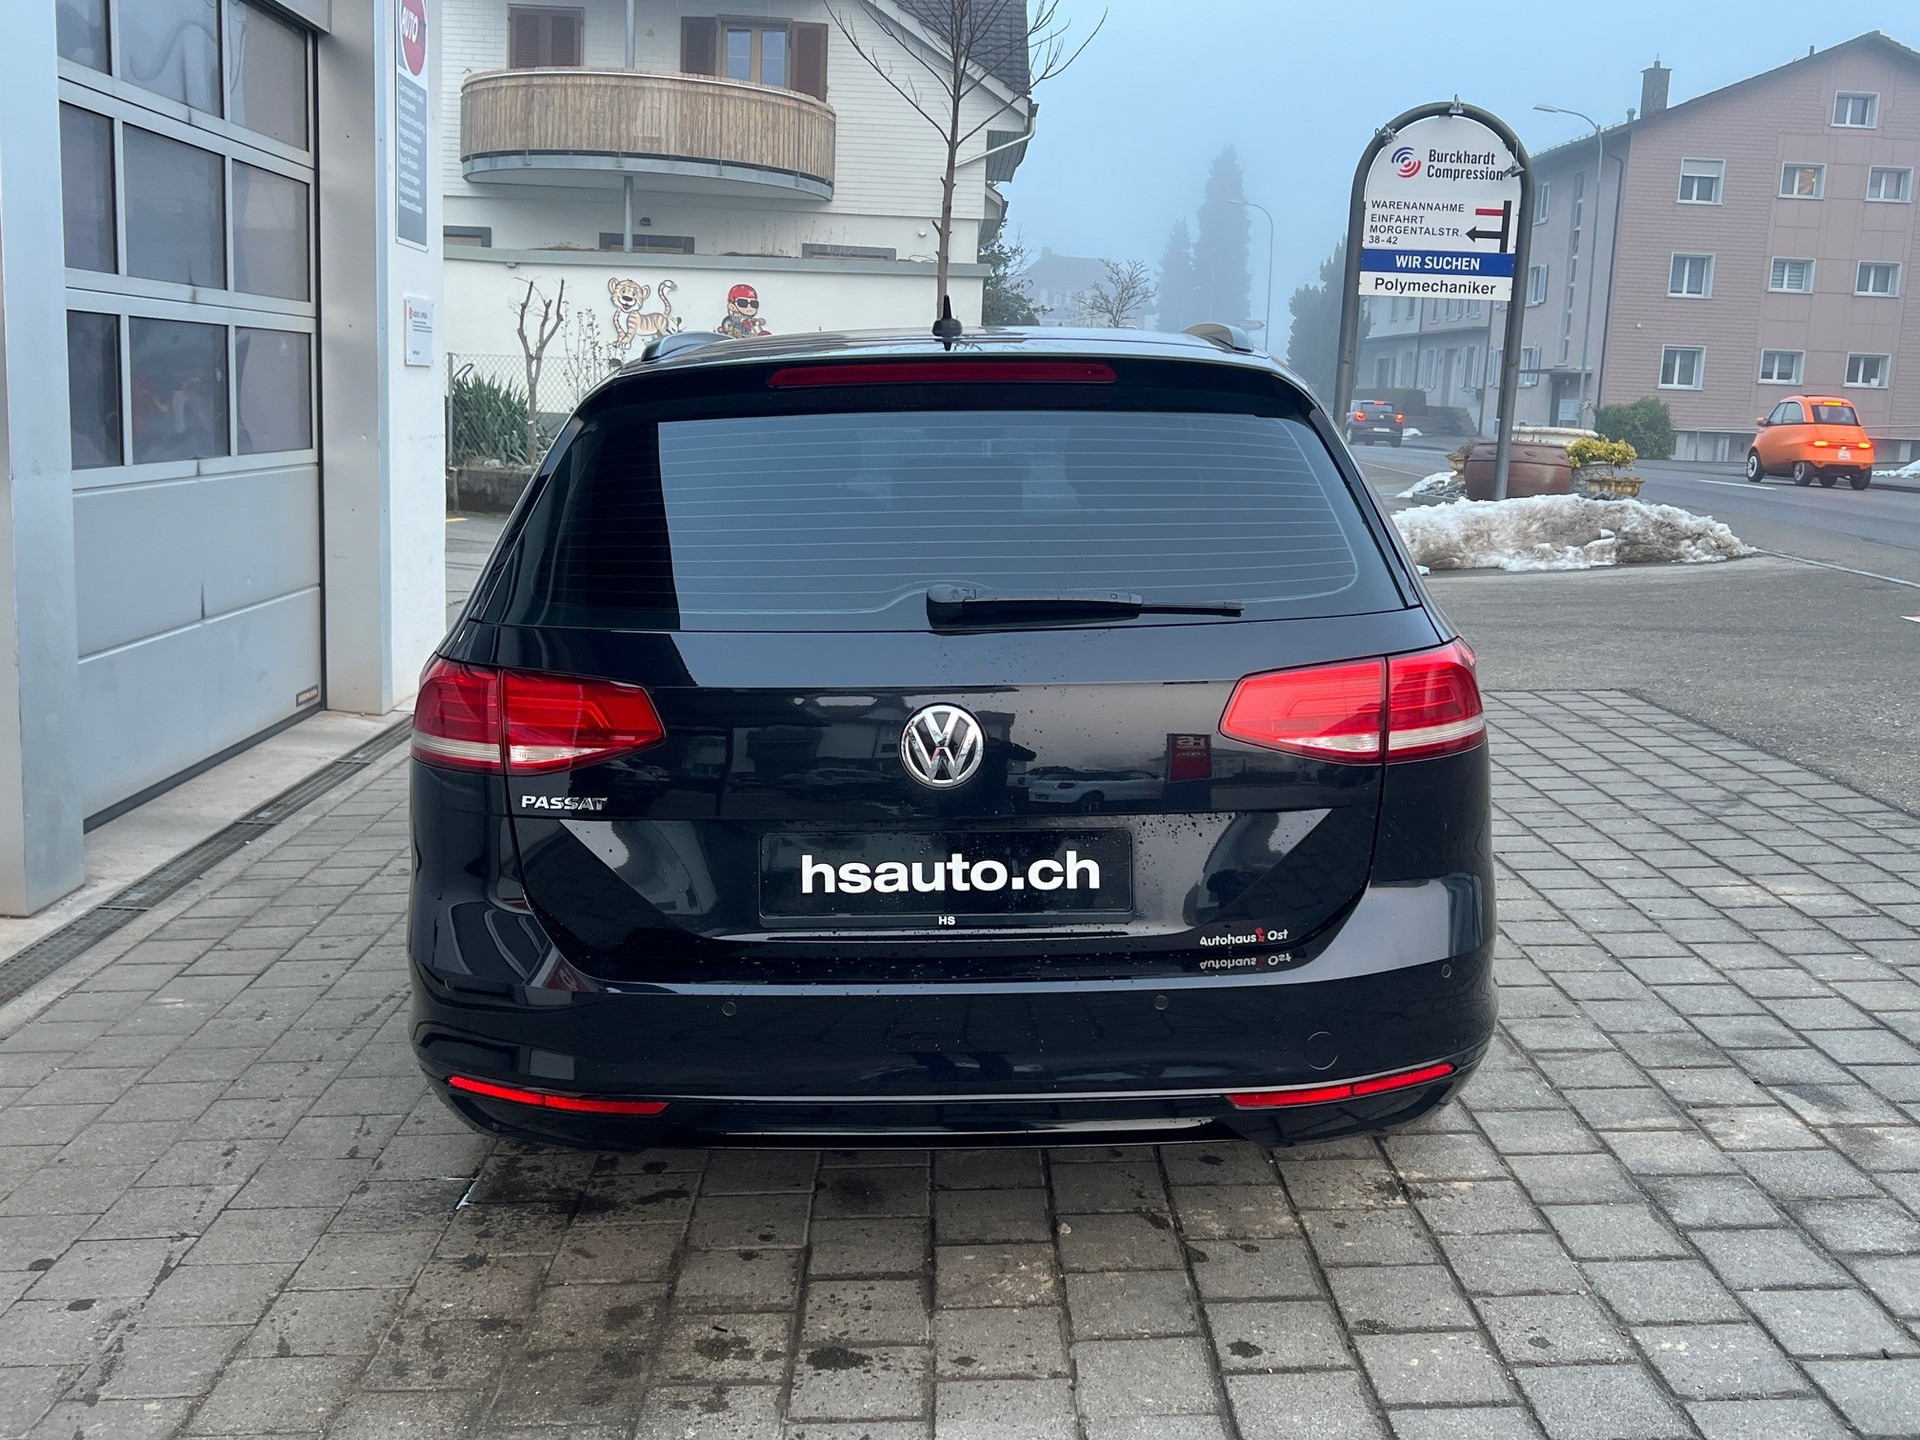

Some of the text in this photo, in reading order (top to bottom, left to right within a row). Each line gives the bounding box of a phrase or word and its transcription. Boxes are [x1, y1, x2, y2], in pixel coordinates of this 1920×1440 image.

[1428, 149, 1496, 166] Burckhardt
[1427, 165, 1503, 181] Compression
[1371, 200, 1465, 213] WARENANNAHME
[1370, 214, 1425, 224] EINFAHRT
[1369, 225, 1462, 237] MORGENTALSTR.
[1395, 254, 1480, 271] WIR SUCHEN
[1374, 277, 1496, 295] Polymechaniker
[521, 795, 608, 811] PASSAT
[801, 850, 1101, 894] hsauto.ch
[938, 915, 956, 926] HS
[1199, 928, 1289, 947] Autohaus Ost
